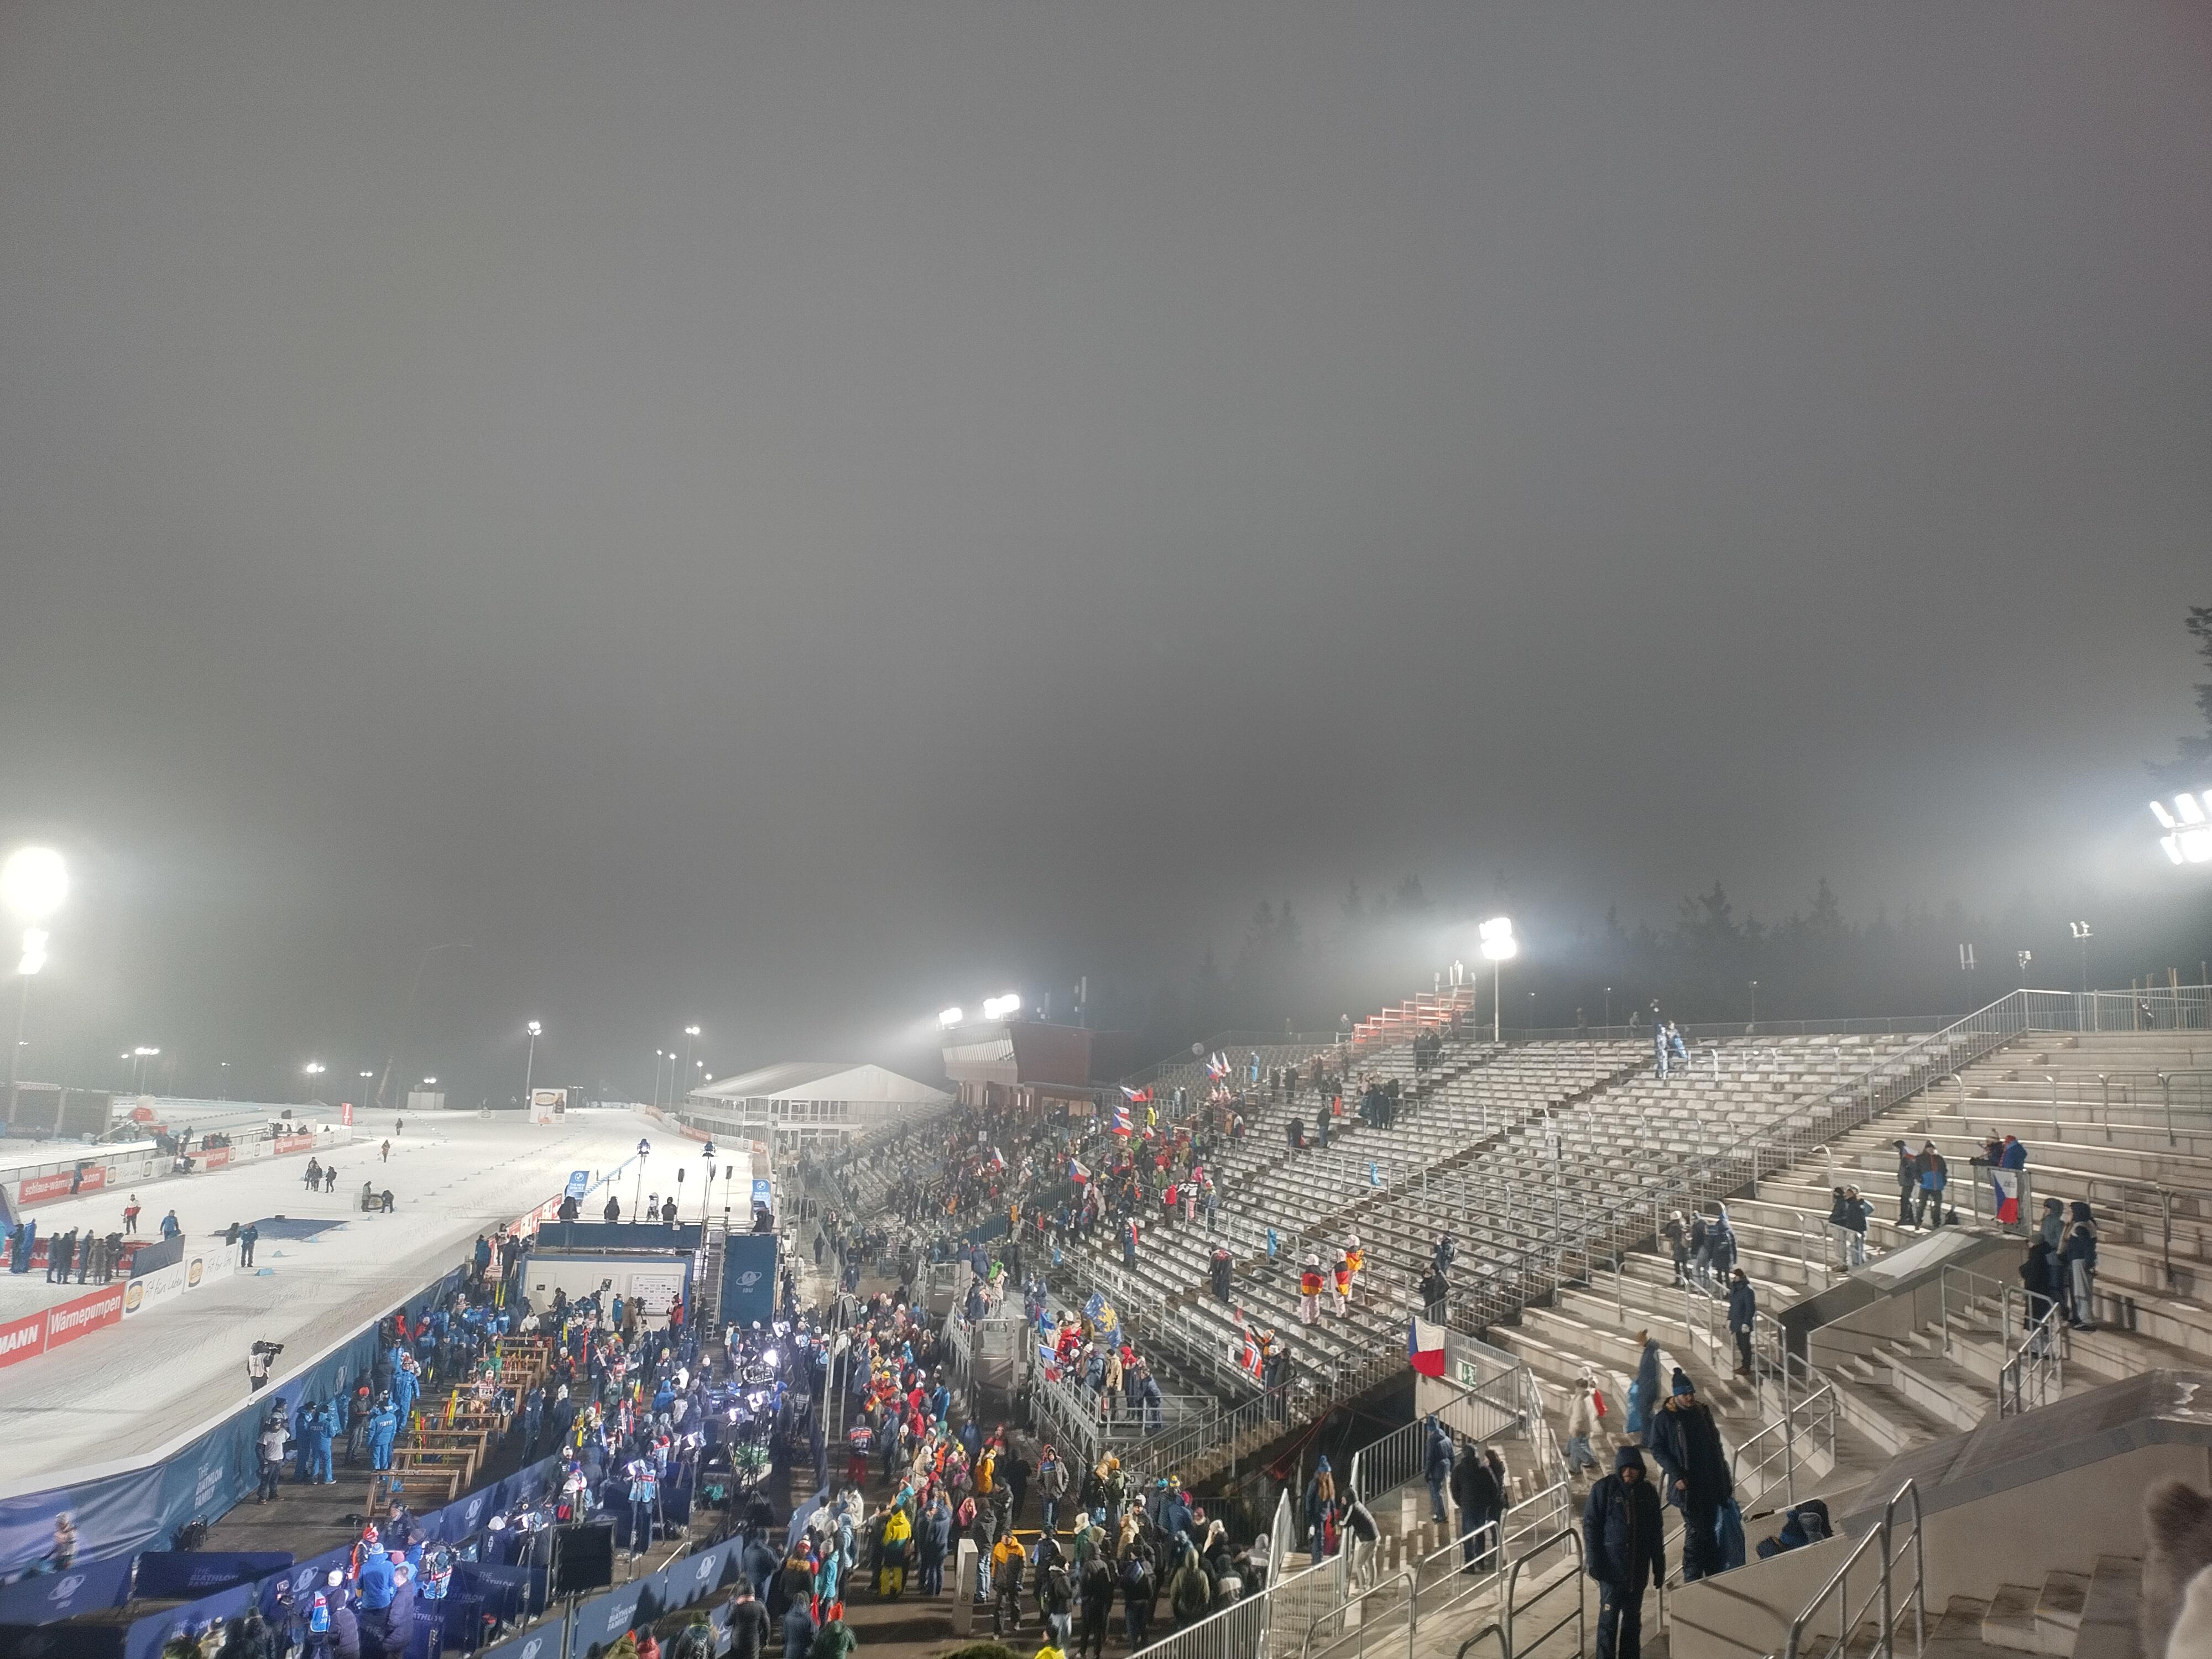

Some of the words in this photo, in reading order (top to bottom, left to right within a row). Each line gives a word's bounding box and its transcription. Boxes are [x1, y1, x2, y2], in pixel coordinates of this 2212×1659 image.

[51, 1295, 121, 1335] Wärmepumpen
[195, 1465, 223, 1497] BIATHLON
[198, 1463, 209, 1480] THE
[194, 1485, 215, 1511] FAMILY
[607, 1615, 629, 1632] FAMILY
[608, 1603, 637, 1624] BIATHLON
